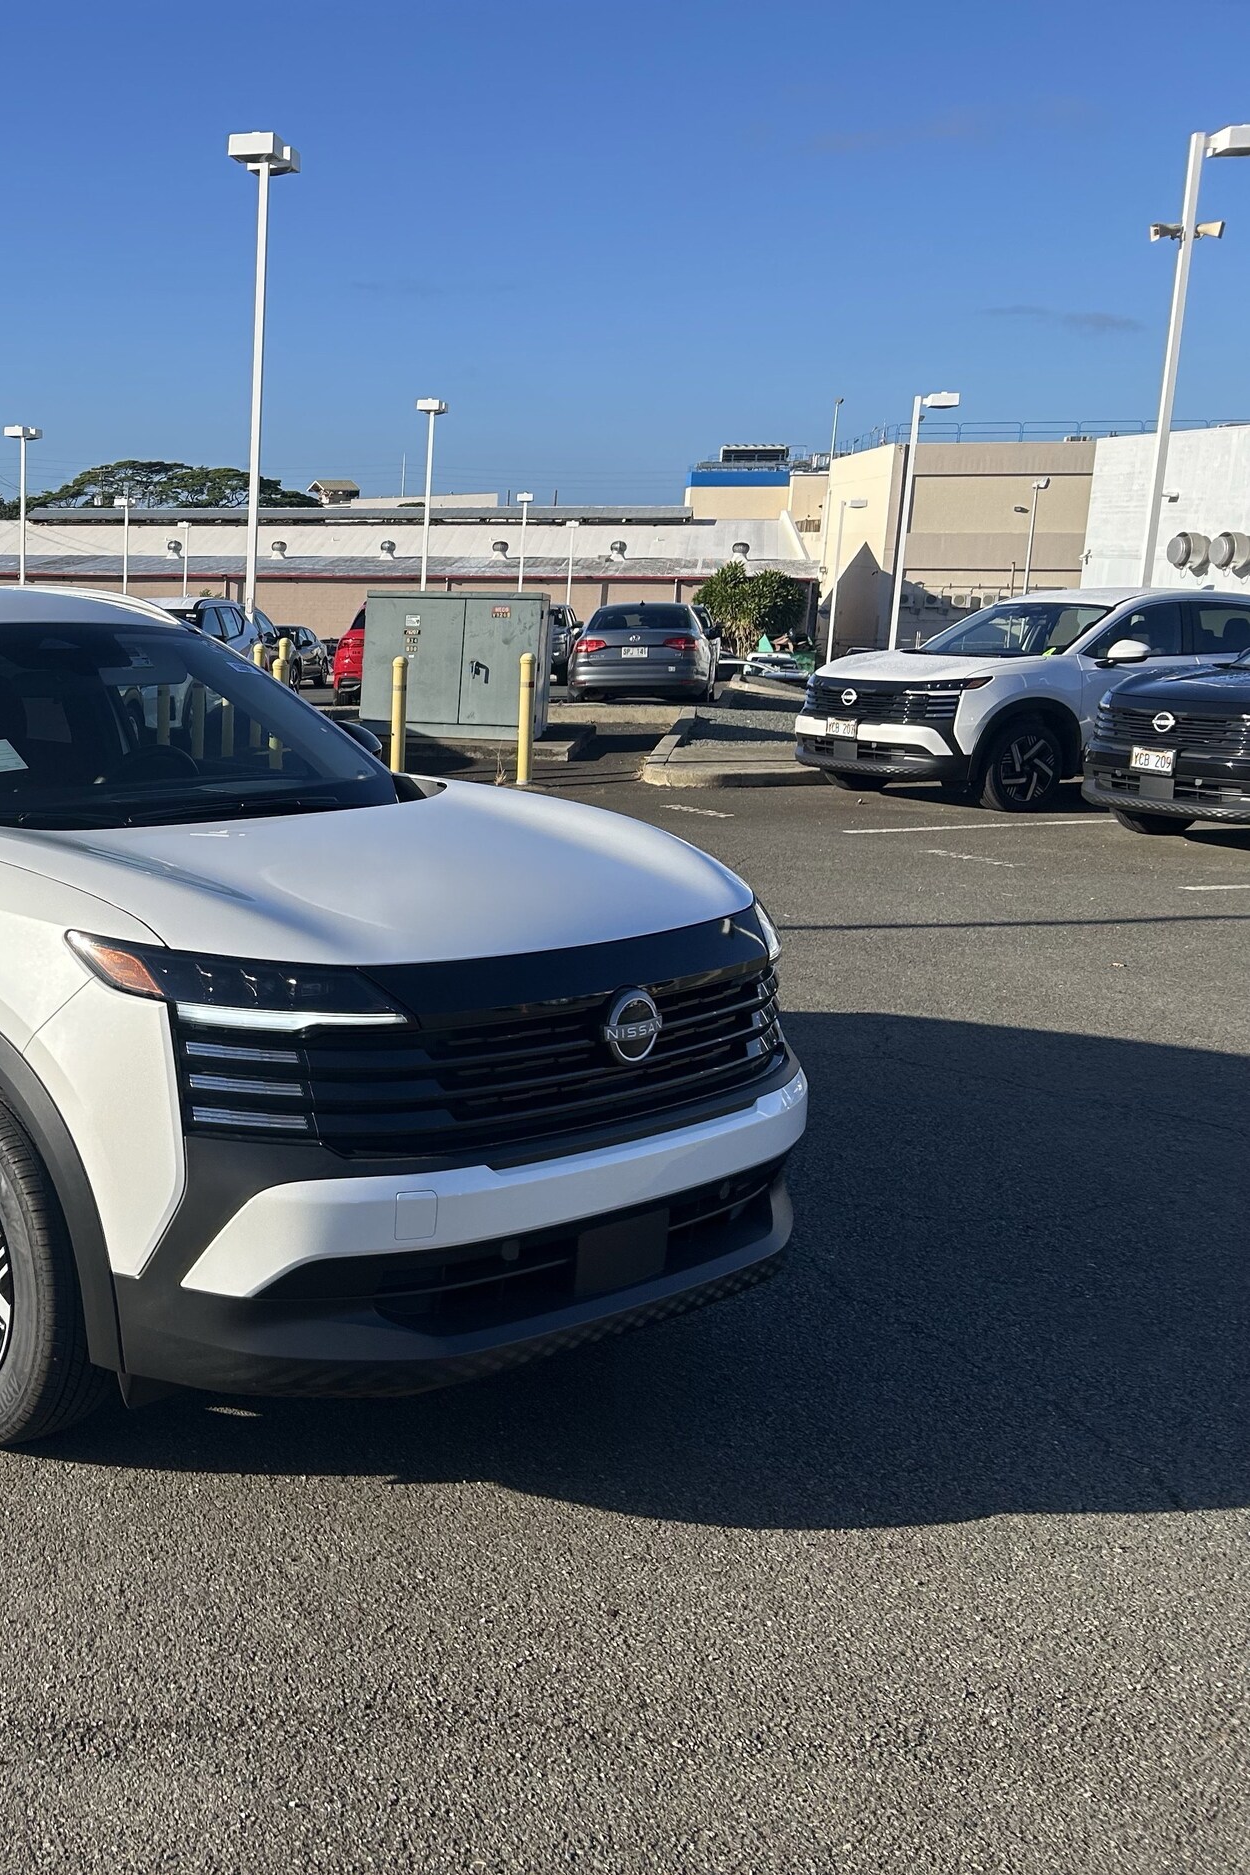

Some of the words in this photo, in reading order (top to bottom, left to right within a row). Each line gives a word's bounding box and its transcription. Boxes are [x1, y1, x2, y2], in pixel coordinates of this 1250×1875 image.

[1134, 752, 1150, 766] YCB
[1155, 755, 1172, 769] 209
[606, 1020, 662, 1039] NISSAN
